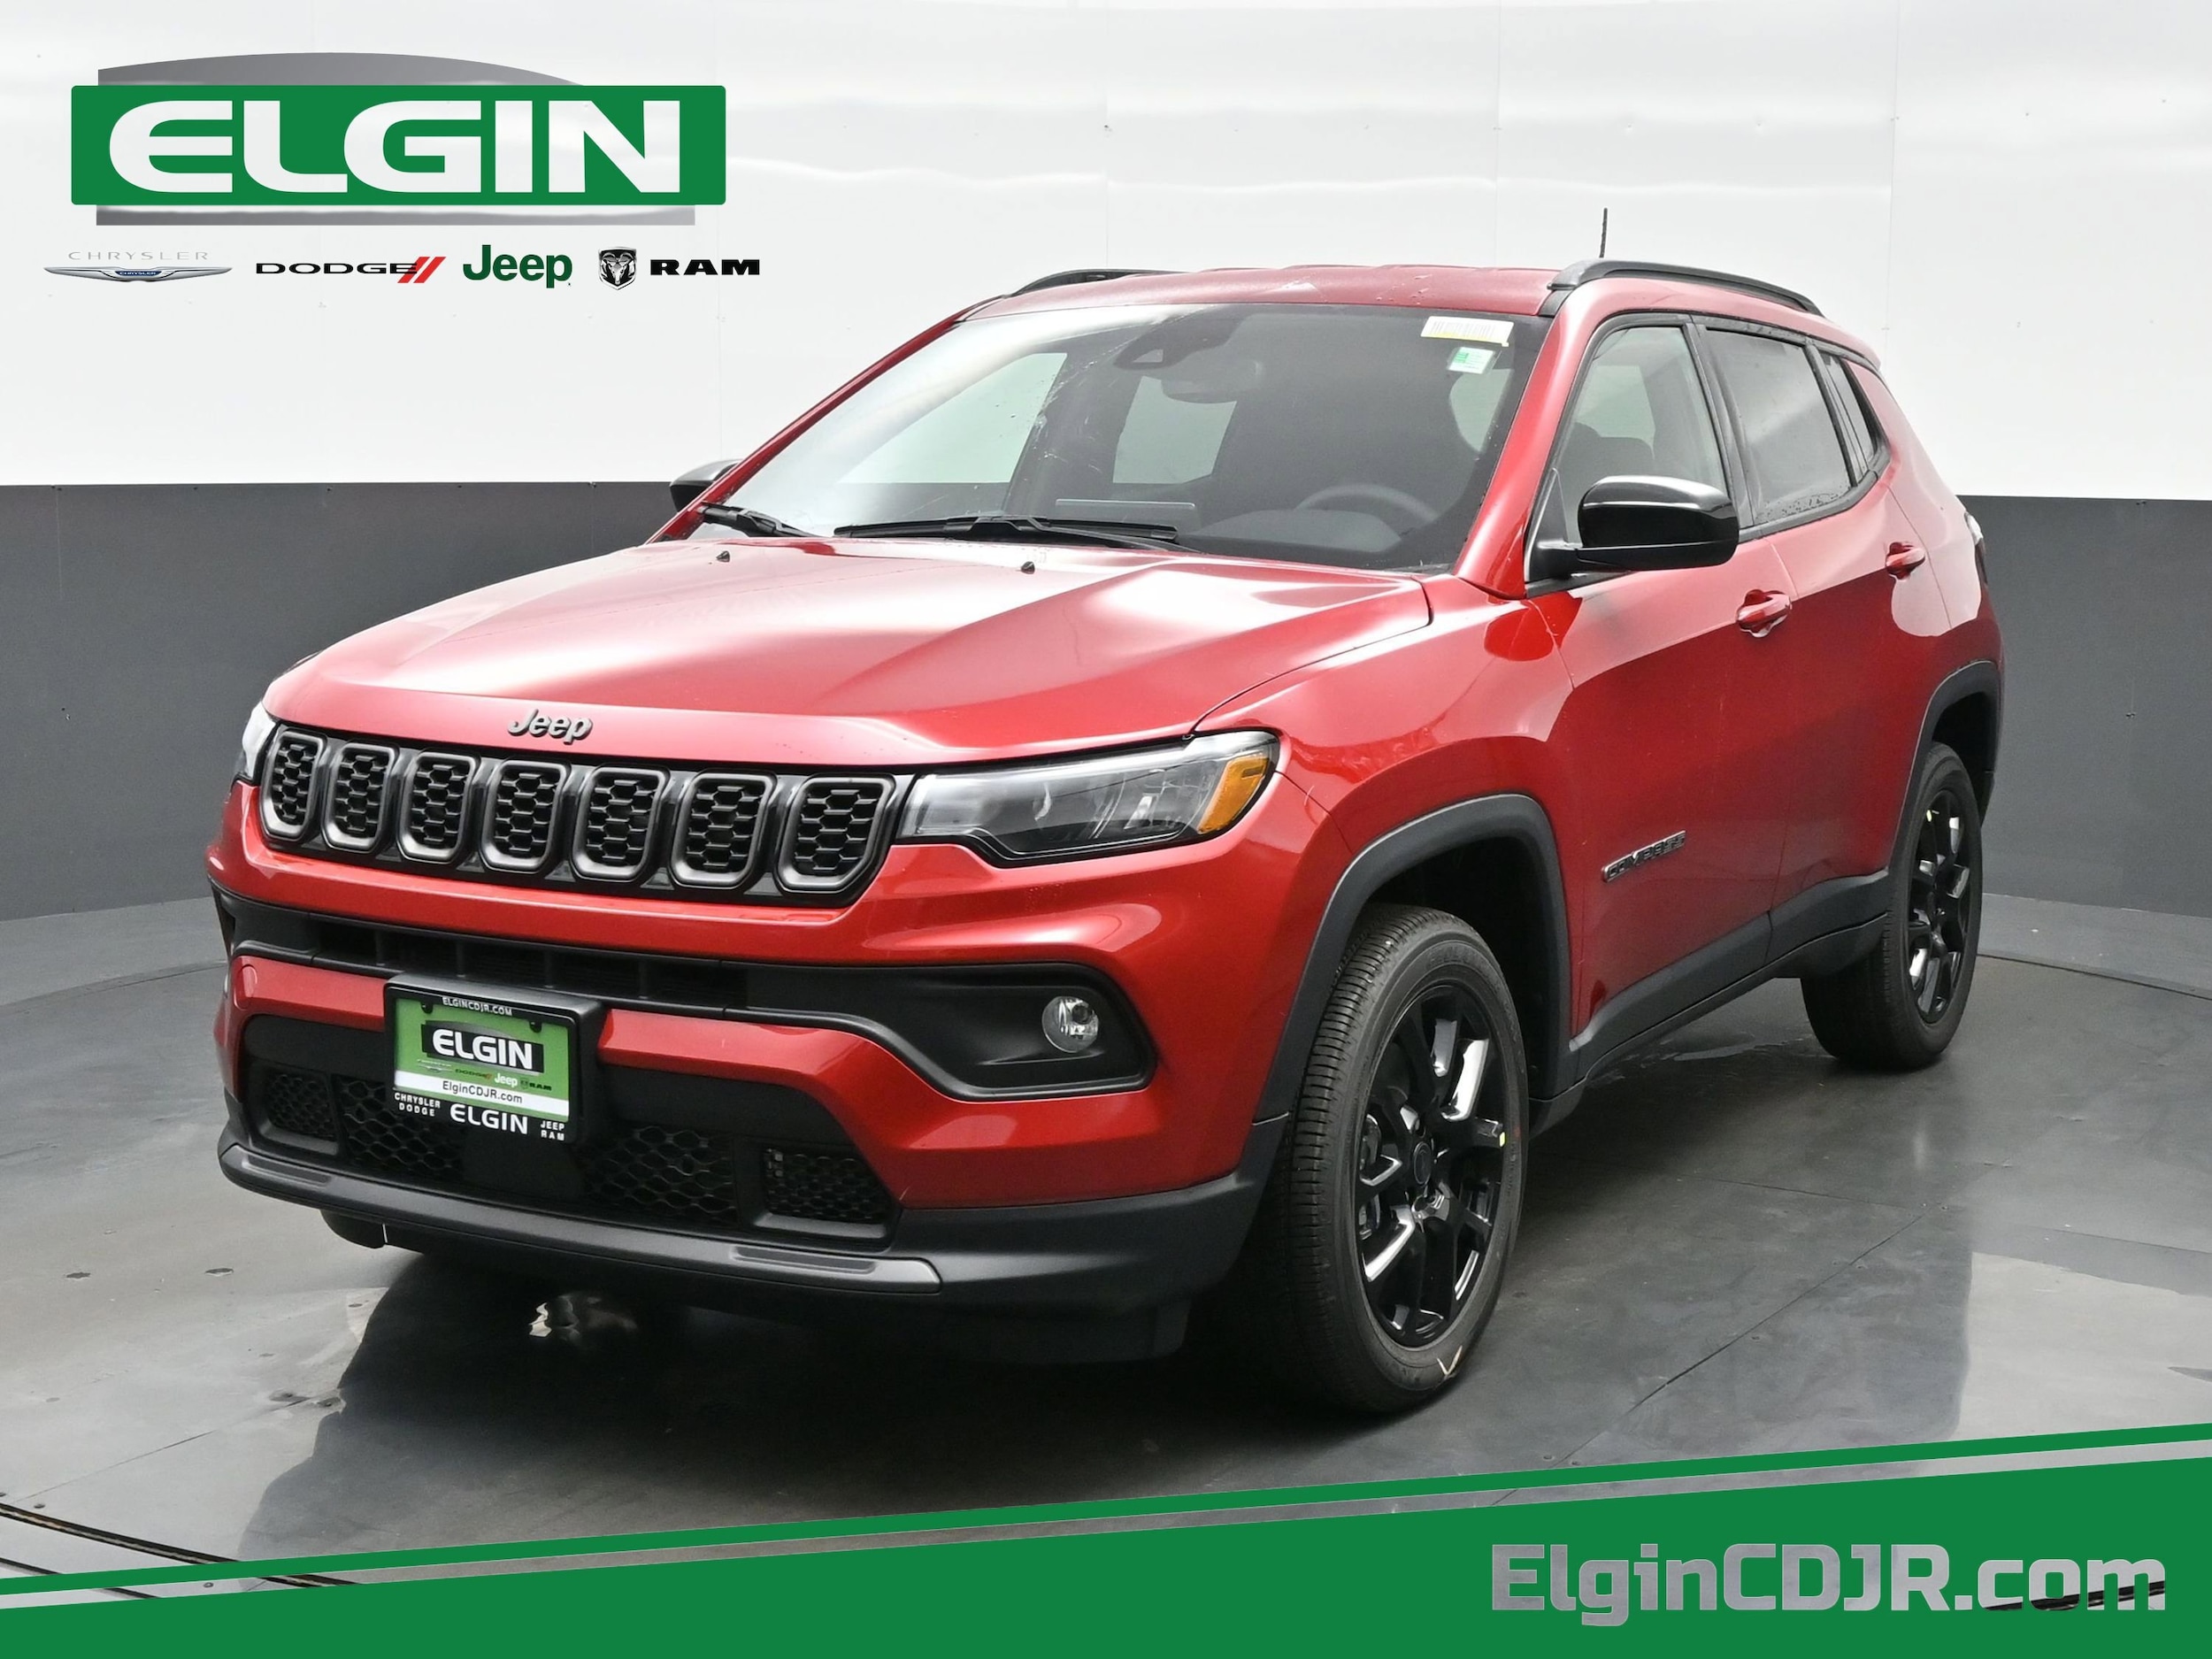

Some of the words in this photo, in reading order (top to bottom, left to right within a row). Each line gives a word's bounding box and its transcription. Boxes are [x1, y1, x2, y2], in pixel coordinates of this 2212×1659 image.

[507, 709, 594, 745] Jeep
[442, 996, 513, 1017] ELGINCDJR.COM
[432, 1028, 534, 1070] ELGIN
[494, 1072, 518, 1088] Jeep
[529, 1082, 552, 1091] RAM
[394, 1092, 442, 1109] CHRYSLER
[442, 1080, 523, 1104] ElginCDJR.com
[398, 1102, 436, 1117] DODGE
[449, 1103, 528, 1135] ELGIN
[540, 1120, 565, 1132] JEEP
[541, 1130, 565, 1141] RAM
